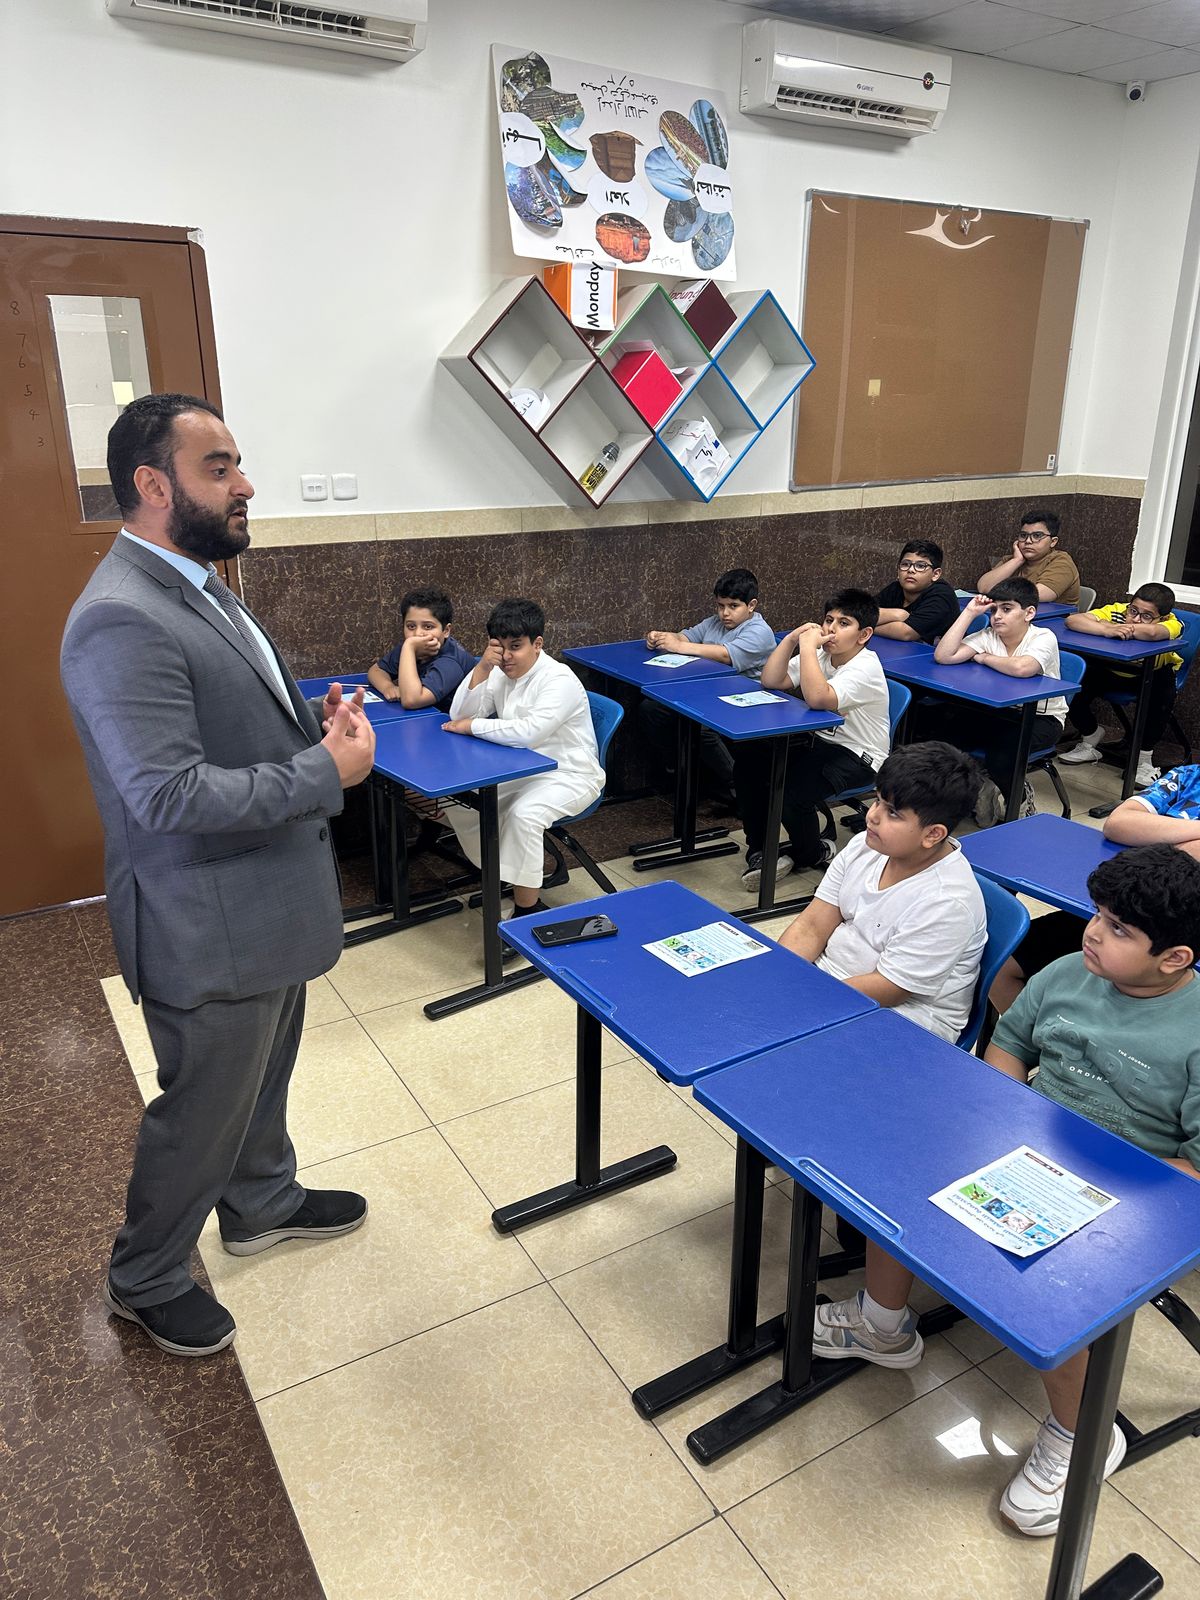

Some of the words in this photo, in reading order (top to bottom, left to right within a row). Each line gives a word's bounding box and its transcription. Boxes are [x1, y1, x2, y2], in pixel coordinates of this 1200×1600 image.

[581, 82, 608, 96] فيصل
[610, 87, 631, 103] تركي
[597, 97, 621, 115] إعداد
[624, 105, 649, 119] الطالب
[696, 181, 731, 198] لطائف
[605, 190, 630, 206] العلا
[586, 261, 604, 328] Monday
[10, 301, 20, 315] 8
[16, 333, 26, 348] 7
[18, 357, 26, 369] 6
[24, 385, 33, 397] 5
[29, 409, 40, 421] 4
[37, 437, 45, 447] 3
